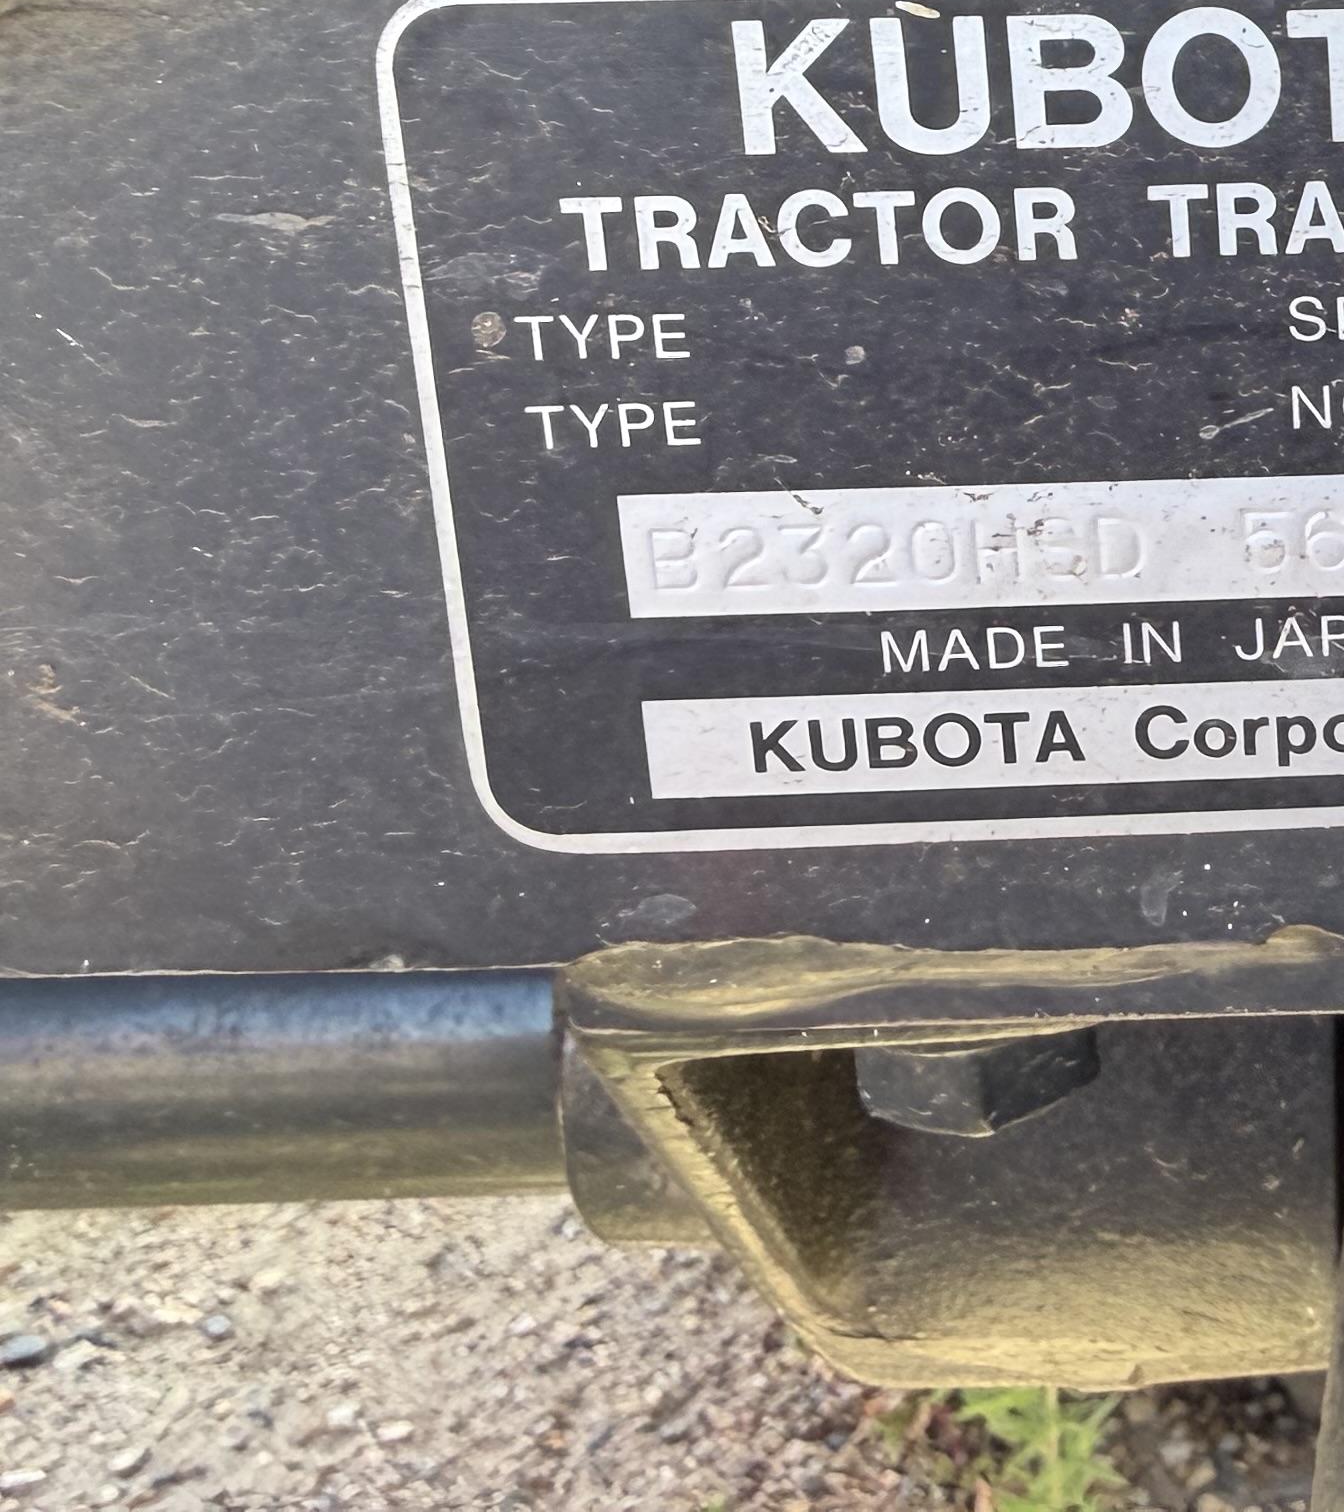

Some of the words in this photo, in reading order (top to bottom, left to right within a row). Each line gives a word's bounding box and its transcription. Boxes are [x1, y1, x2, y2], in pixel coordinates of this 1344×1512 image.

[559, 187, 1078, 271] TRACTOR
[514, 314, 691, 361] TYPE
[525, 400, 702, 450] TYPE
[881, 624, 1069, 674] MADE
[1122, 619, 1181, 665] IN
[750, 710, 1082, 774] KUBOTA
